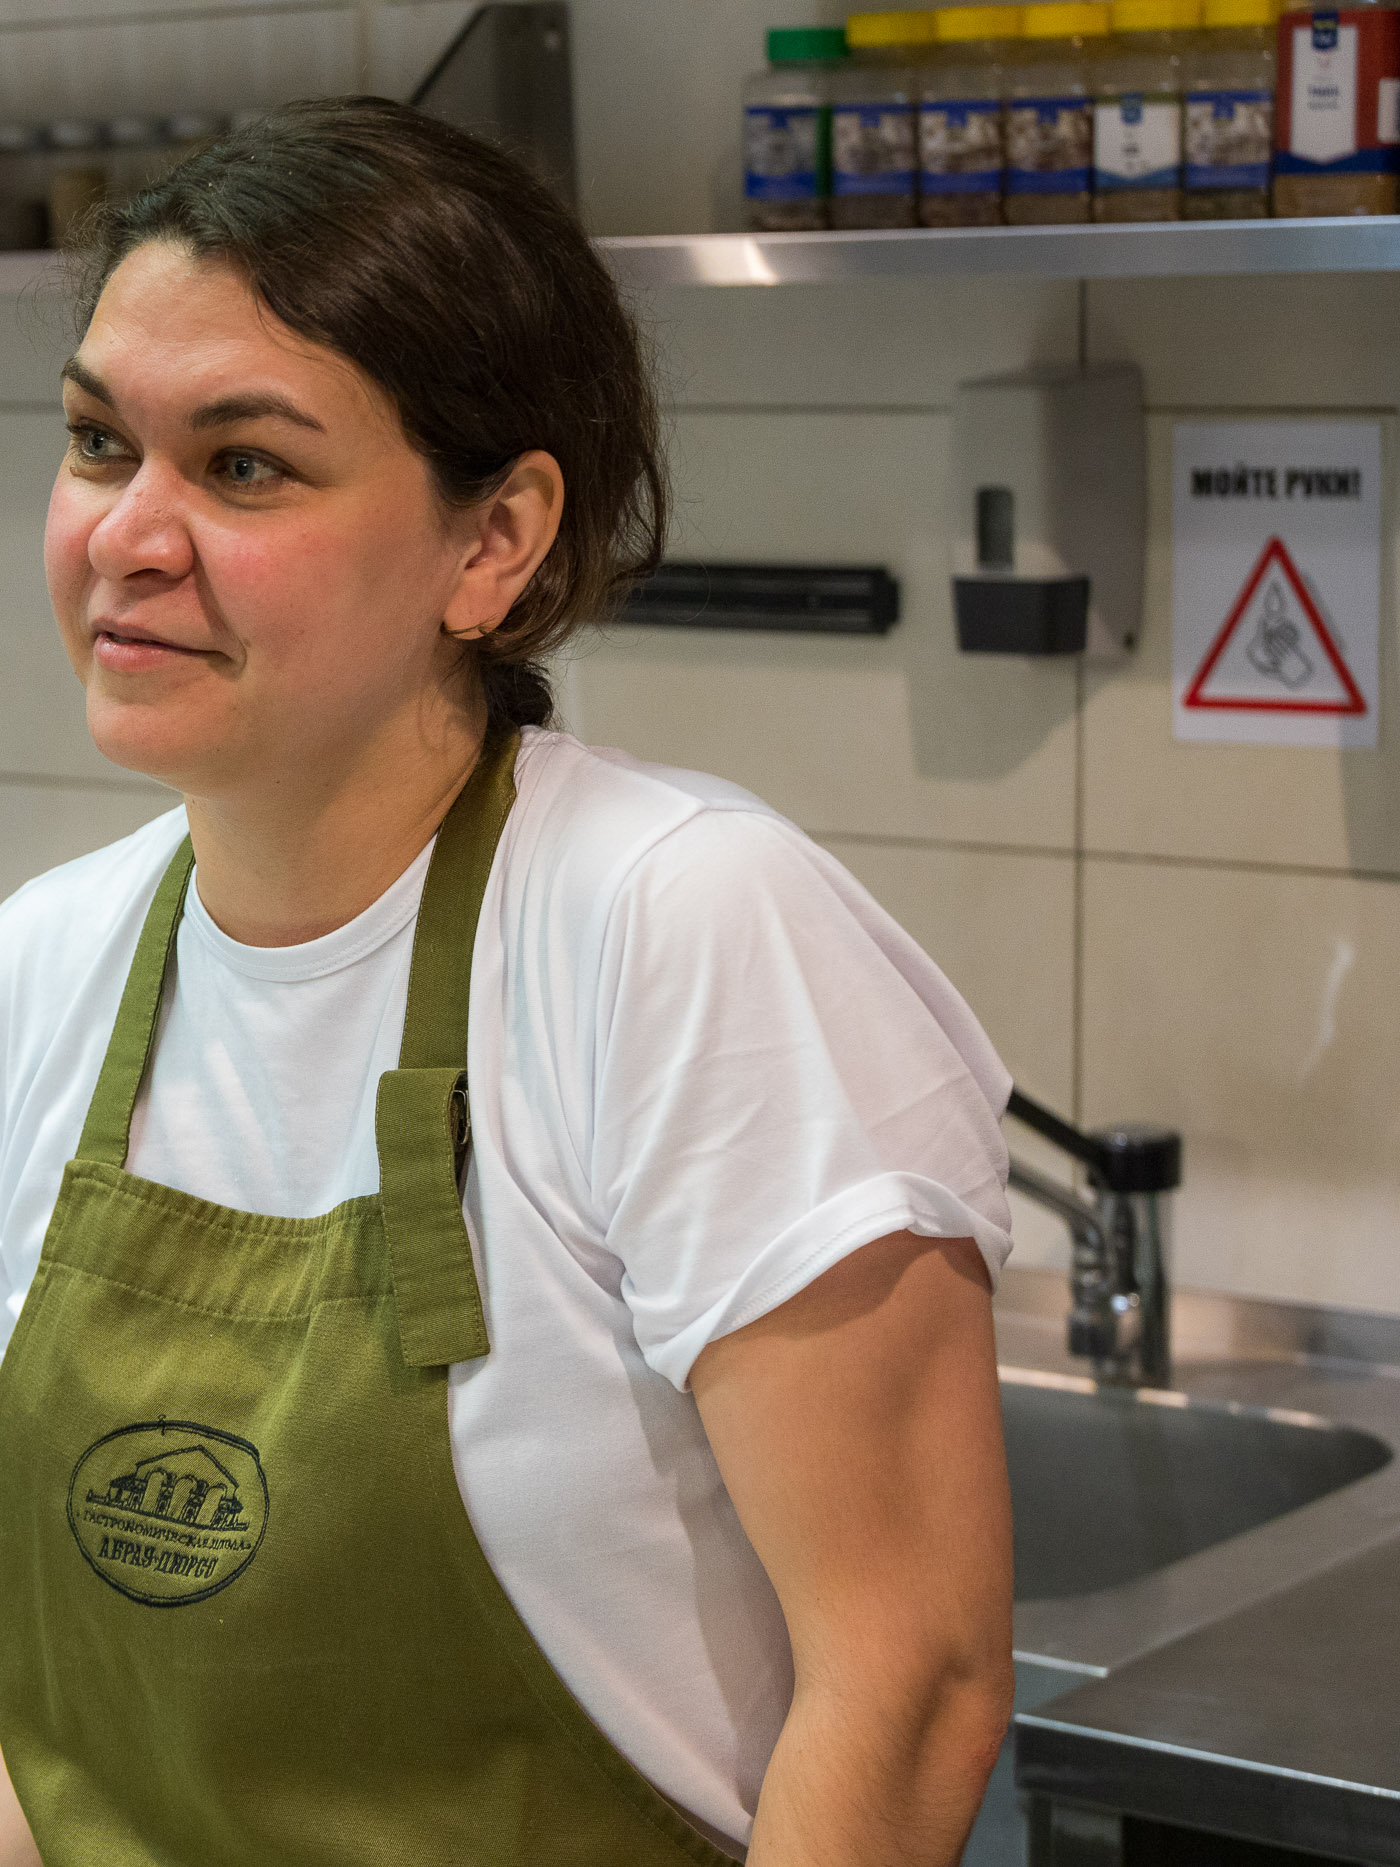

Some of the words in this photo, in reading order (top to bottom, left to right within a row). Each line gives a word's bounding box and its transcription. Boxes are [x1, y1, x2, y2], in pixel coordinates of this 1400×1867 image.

[1190, 460, 1277, 498] МОЙТЕ
[1285, 466, 1361, 500] РУКИ!
[97, 1534, 220, 1579] АБРАУ-ДЮРСО
